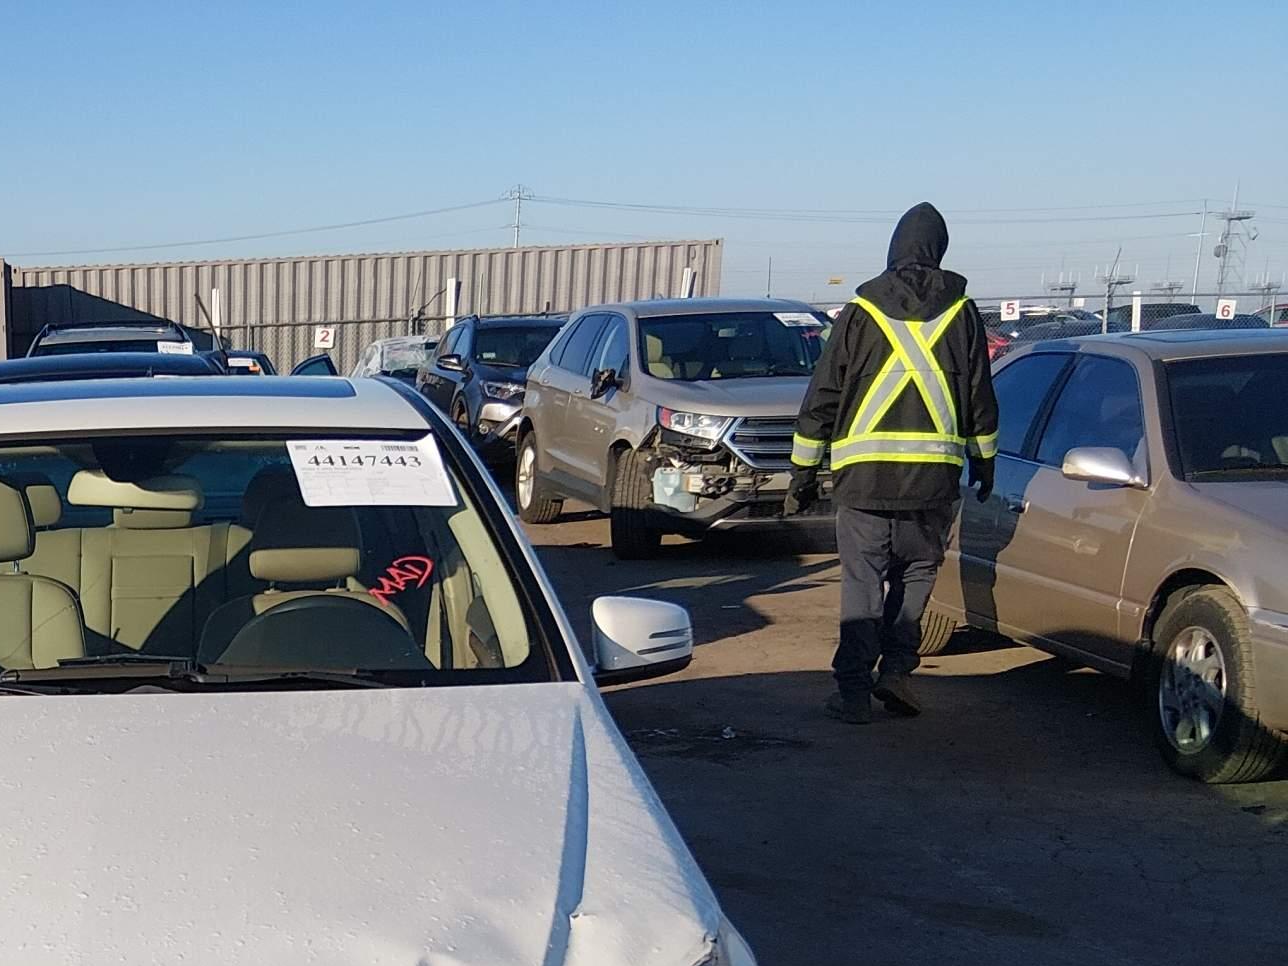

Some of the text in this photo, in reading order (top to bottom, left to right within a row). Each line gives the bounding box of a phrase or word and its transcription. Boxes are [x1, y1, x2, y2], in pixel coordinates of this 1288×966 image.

[1006, 302, 1015, 315] 5
[1221, 304, 1231, 317] 6
[319, 330, 330, 342] 2
[307, 455, 422, 467] 44147443
[367, 555, 434, 608] MAD
